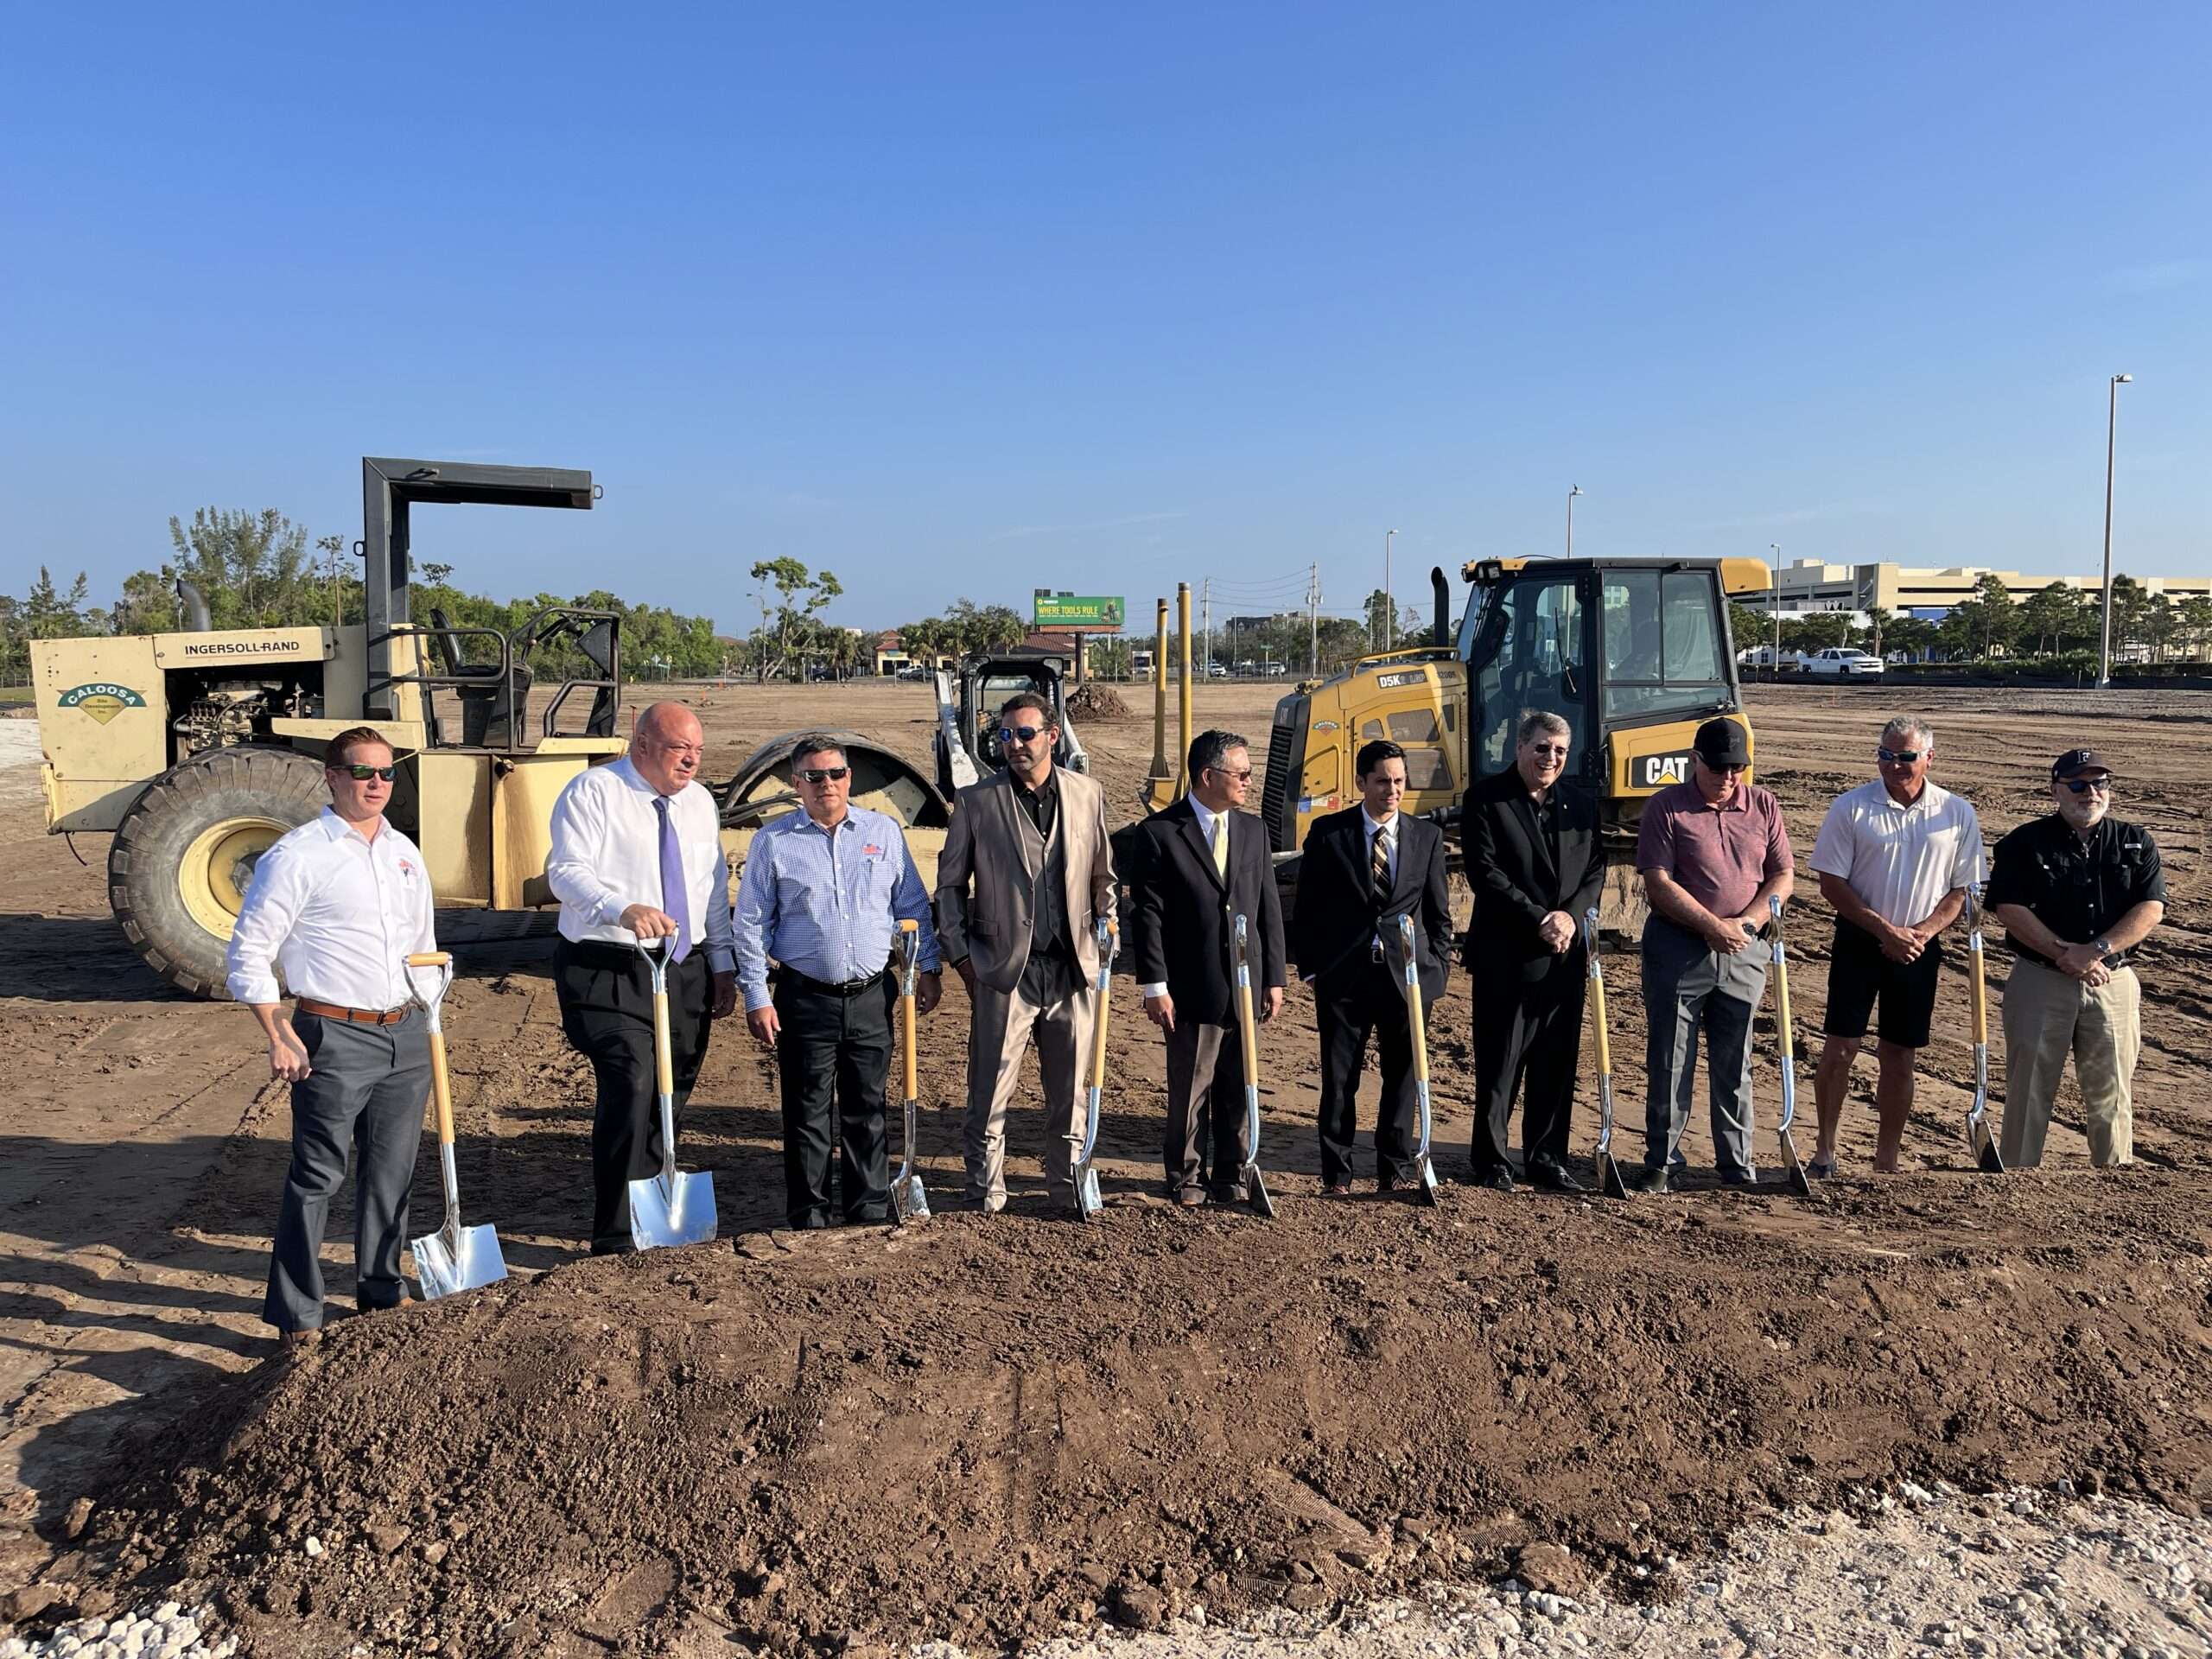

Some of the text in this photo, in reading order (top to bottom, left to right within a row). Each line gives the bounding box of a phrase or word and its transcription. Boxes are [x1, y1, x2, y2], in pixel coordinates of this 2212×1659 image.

[1039, 606, 1098, 614] WHERE TOOLS RULE
[185, 641, 299, 654] INGERSOLL-RAND
[67, 685, 136, 705] CALOOSA
[1646, 757, 1688, 785] CAT
